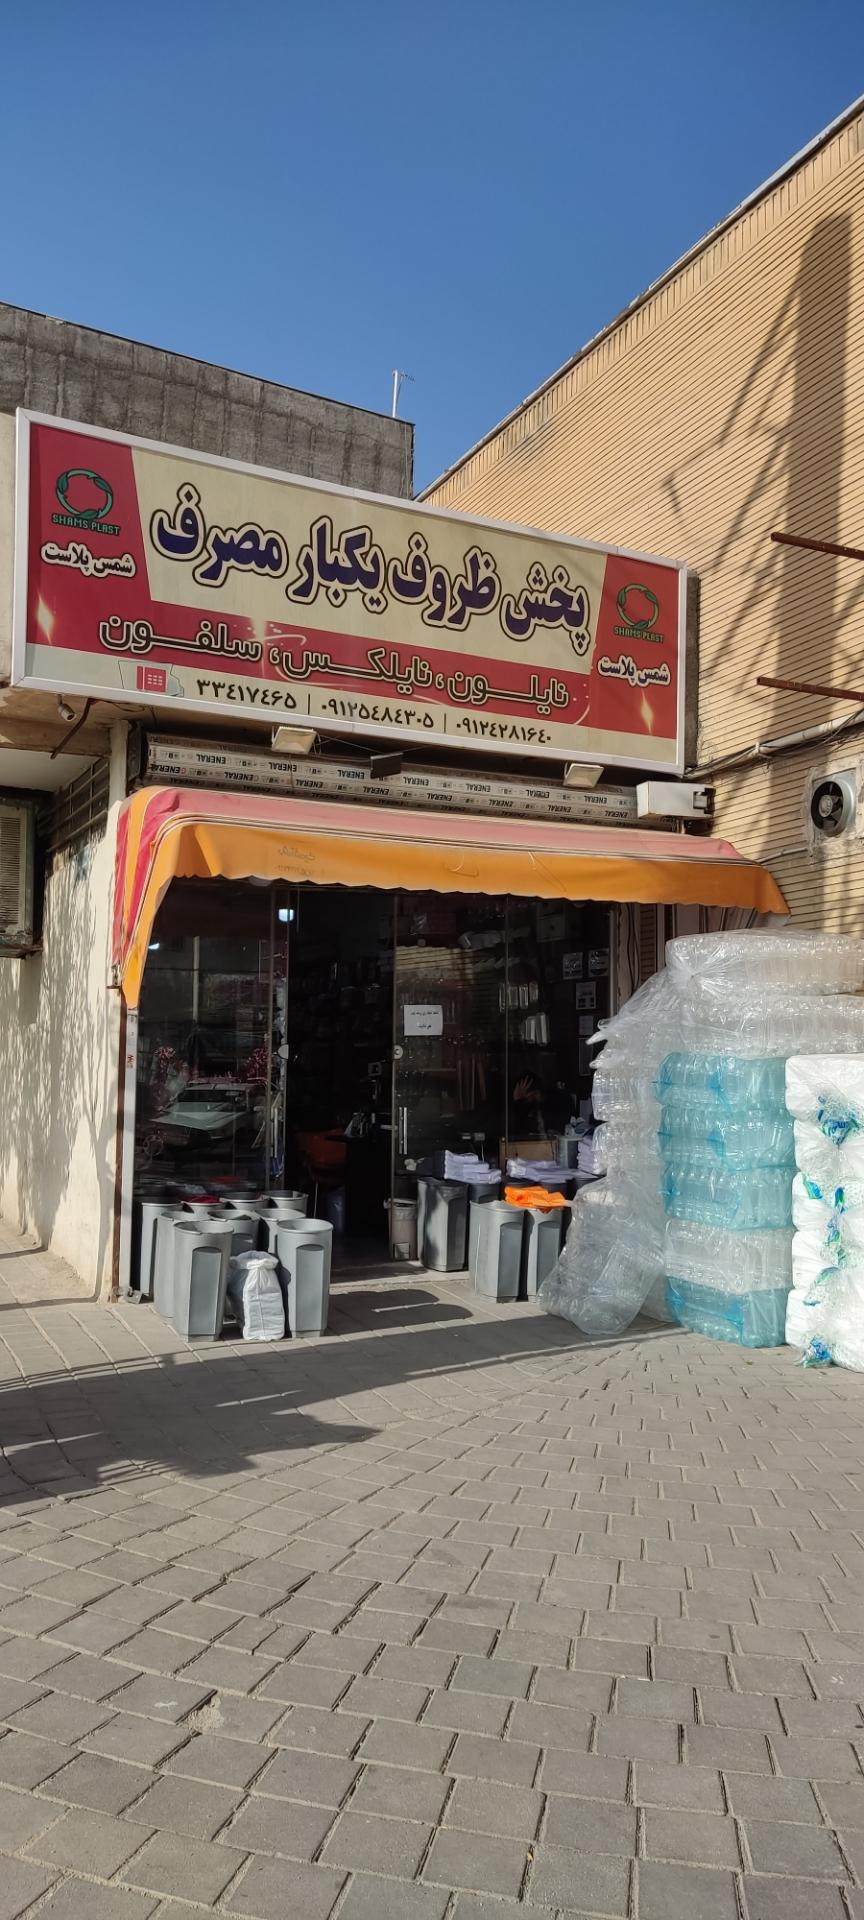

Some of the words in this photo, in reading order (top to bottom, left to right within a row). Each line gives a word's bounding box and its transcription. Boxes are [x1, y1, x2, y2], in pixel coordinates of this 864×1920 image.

[52, 513, 88, 528] SHAMS
[91, 521, 120, 535] PLAST
[153, 485, 286, 584] مصرف
[43, 544, 90, 574] پلاست
[93, 555, 134, 575] شمس
[288, 517, 384, 611] یکبار
[390, 535, 499, 628] ظروف
[502, 564, 588, 653] پخش
[100, 615, 263, 661] سلفون
[614, 626, 640, 638] SHAMS
[642, 631, 664, 643] PLAST
[599, 656, 636, 684] پلاست
[637, 665, 670, 685] شمس
